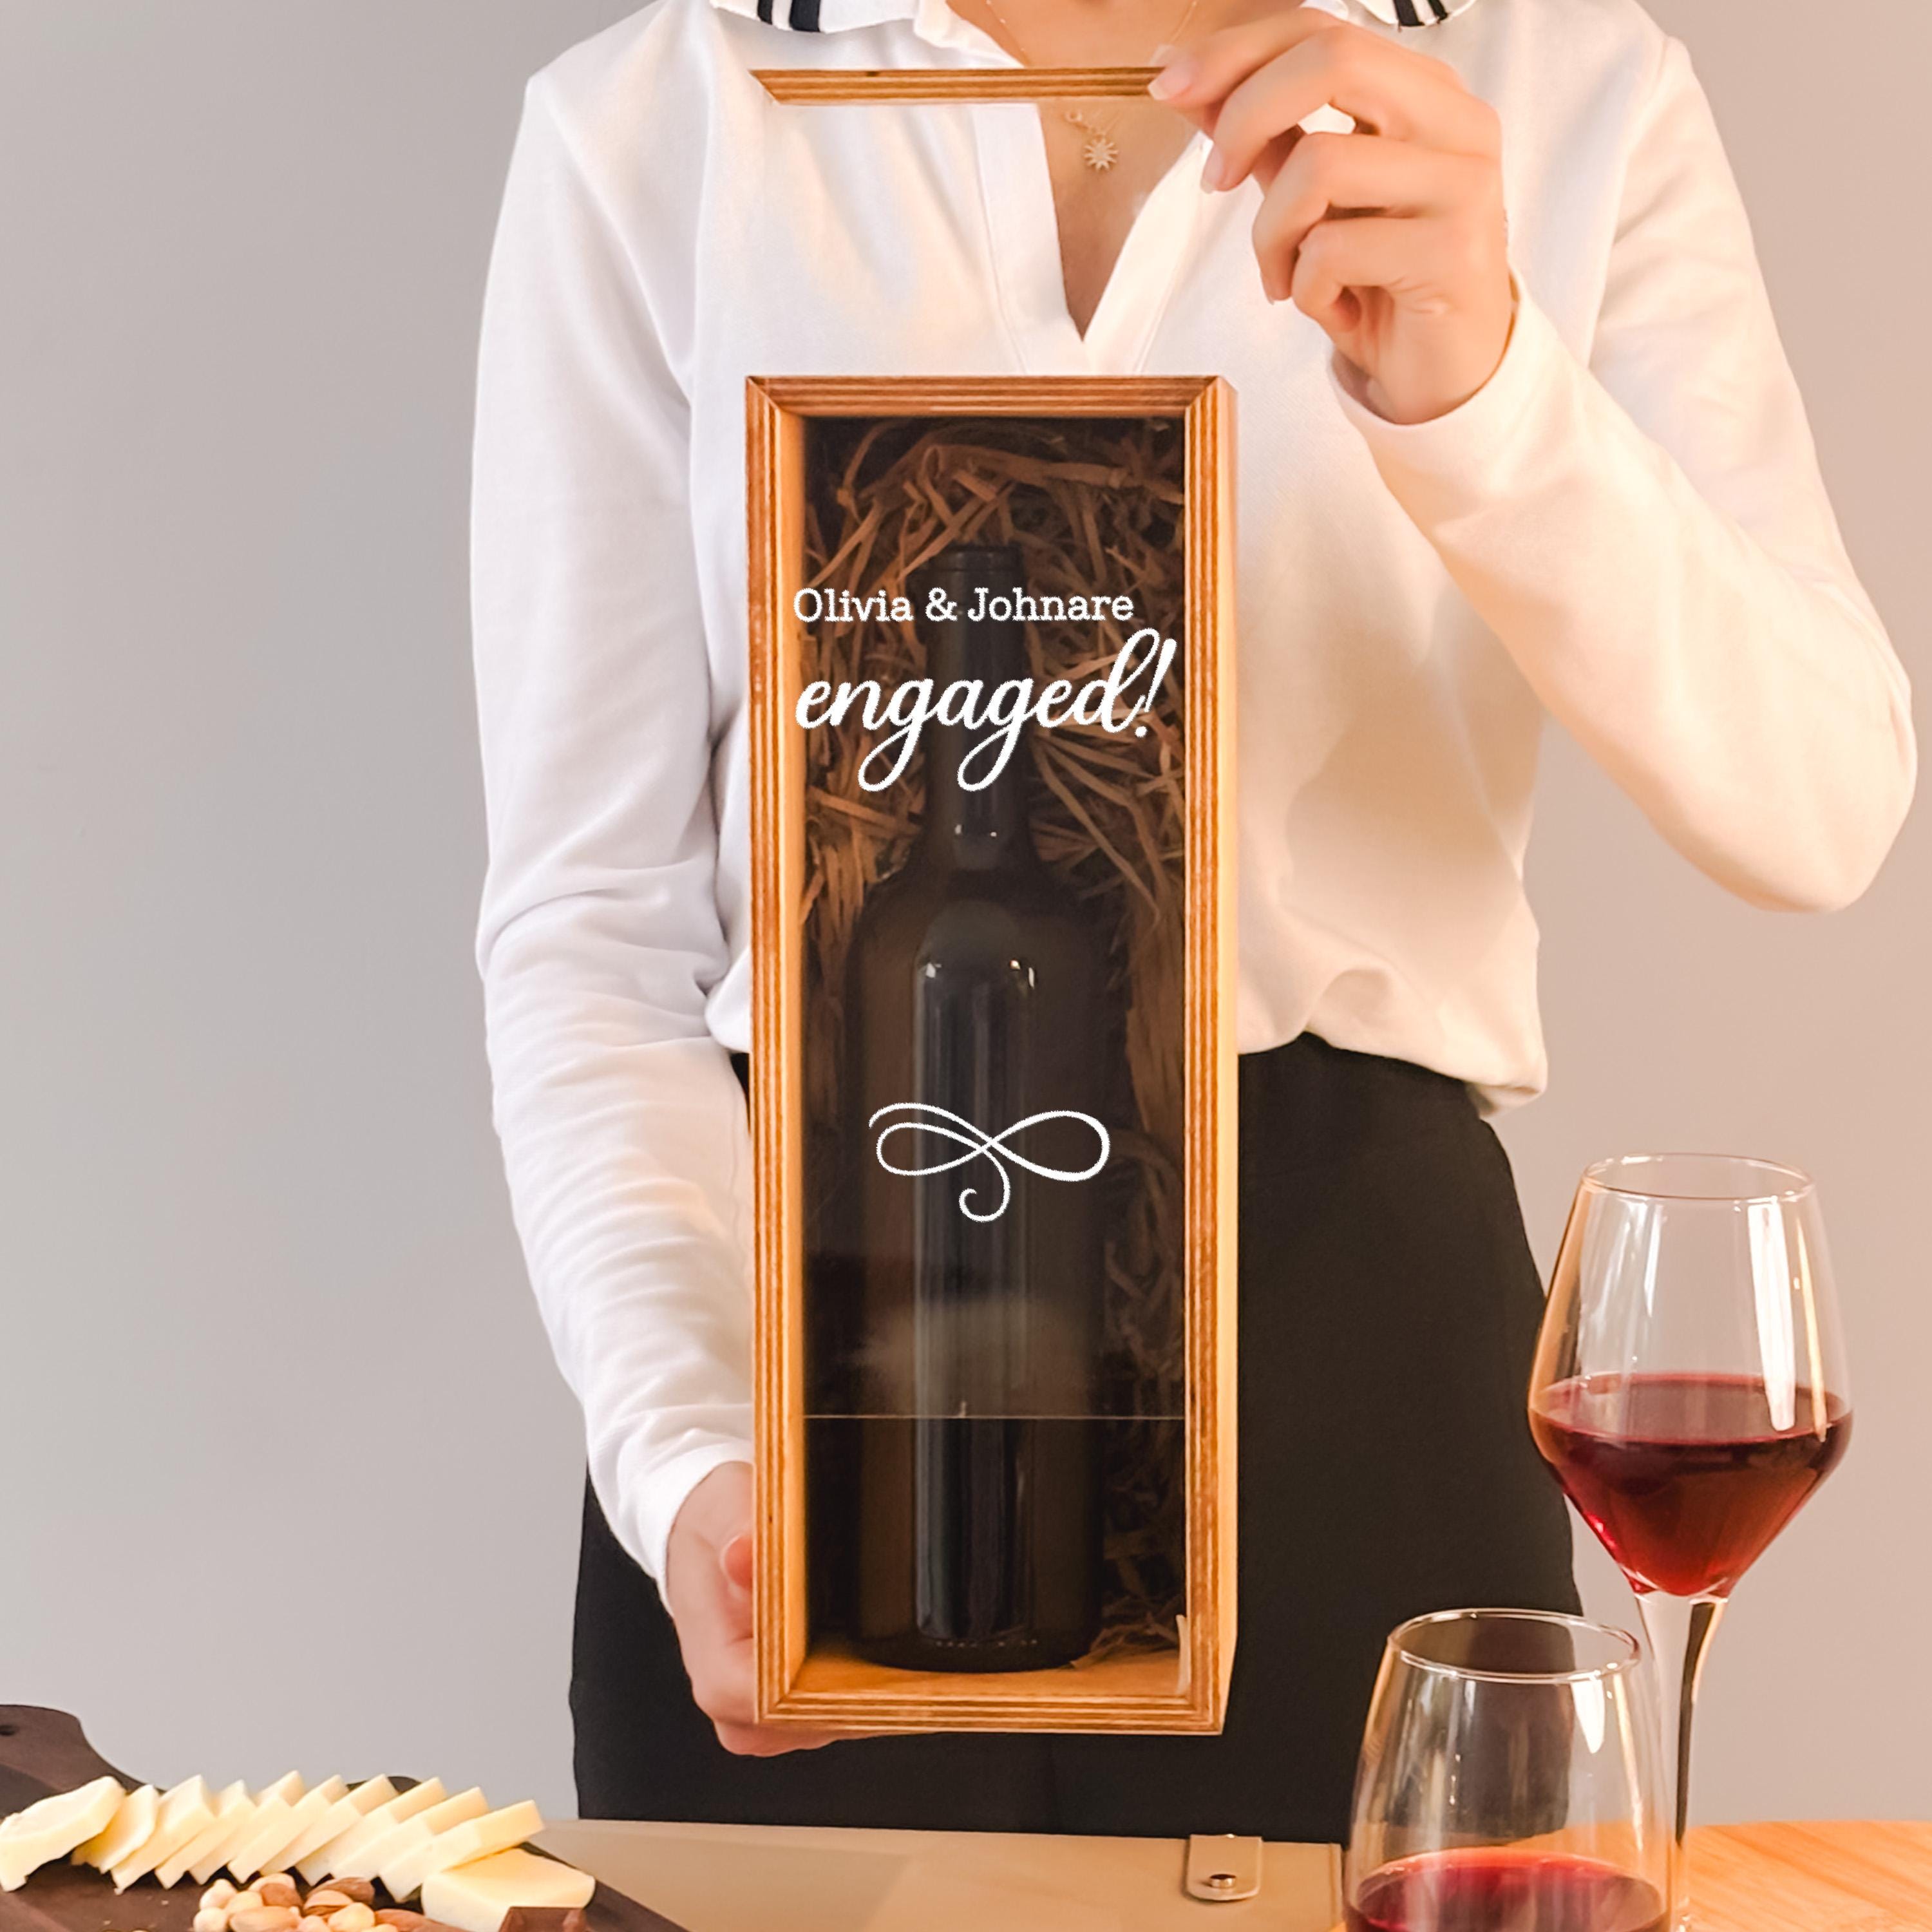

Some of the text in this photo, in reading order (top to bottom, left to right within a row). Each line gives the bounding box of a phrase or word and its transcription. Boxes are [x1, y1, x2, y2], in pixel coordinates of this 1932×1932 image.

[793, 587, 913, 622] Olivia
[925, 587, 958, 622] &
[795, 628, 1177, 792] engaged!
